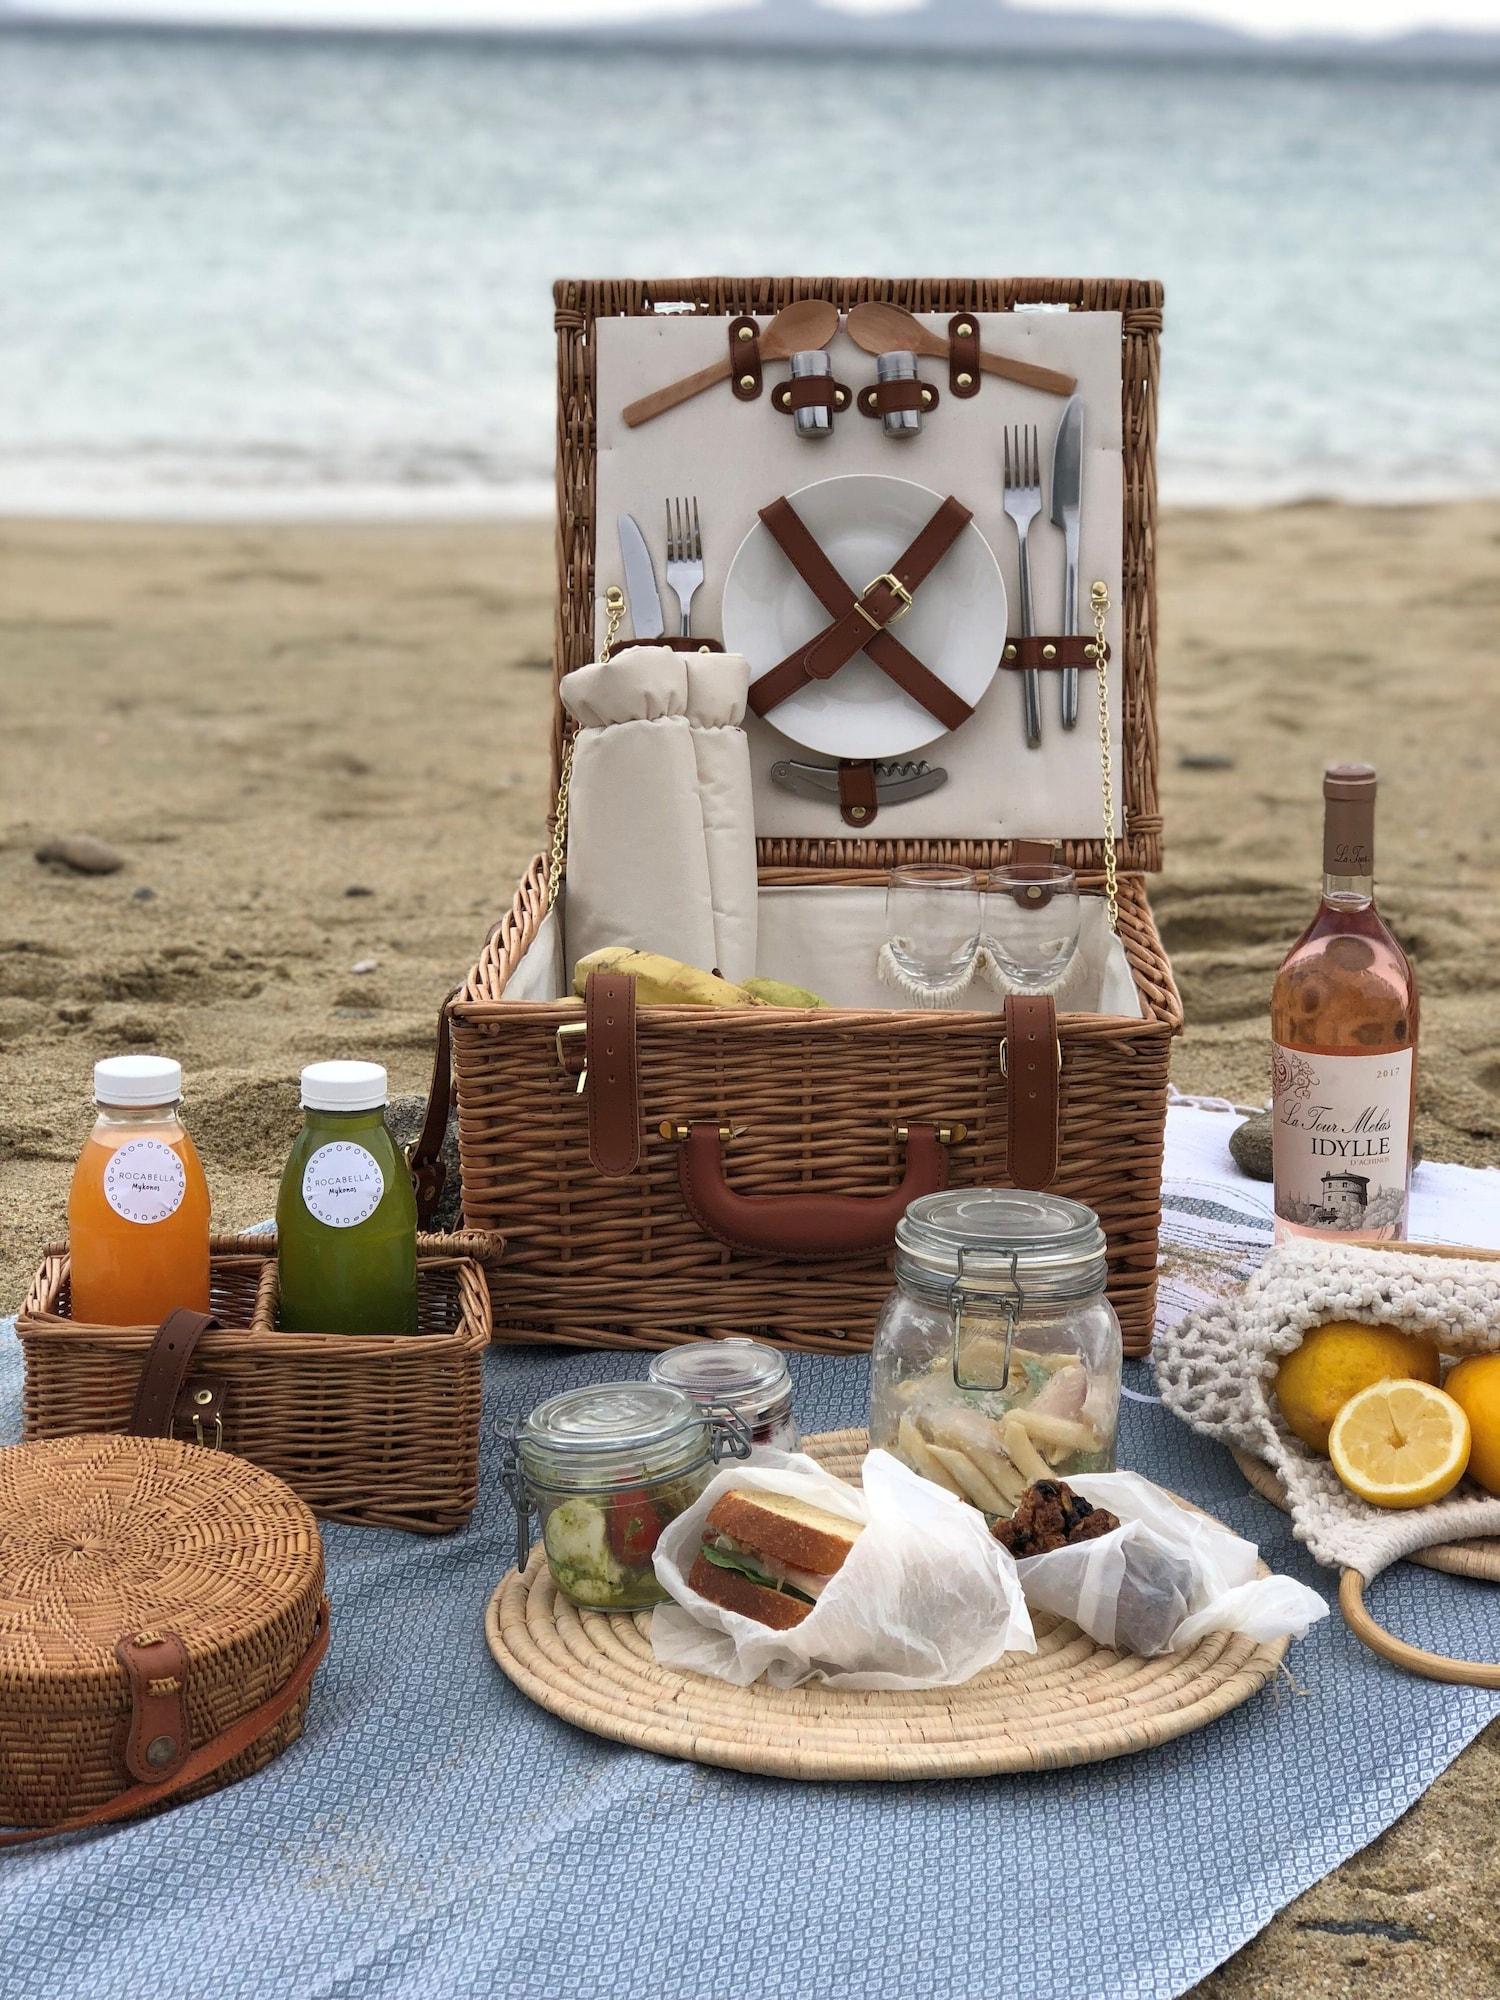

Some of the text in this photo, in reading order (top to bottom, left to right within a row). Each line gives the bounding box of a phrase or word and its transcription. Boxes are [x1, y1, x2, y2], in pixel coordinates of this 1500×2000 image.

[1377, 1067, 1400, 1079] 2017
[1280, 1099, 1391, 1134] La Tour Melas
[1311, 1137, 1390, 1157] IDYLLE
[118, 1172, 175, 1182] ROCABELLA
[315, 1174, 370, 1187] ROCABELLA
[131, 1183, 160, 1193] Mykonos
[328, 1187, 357, 1197] Mykonos
